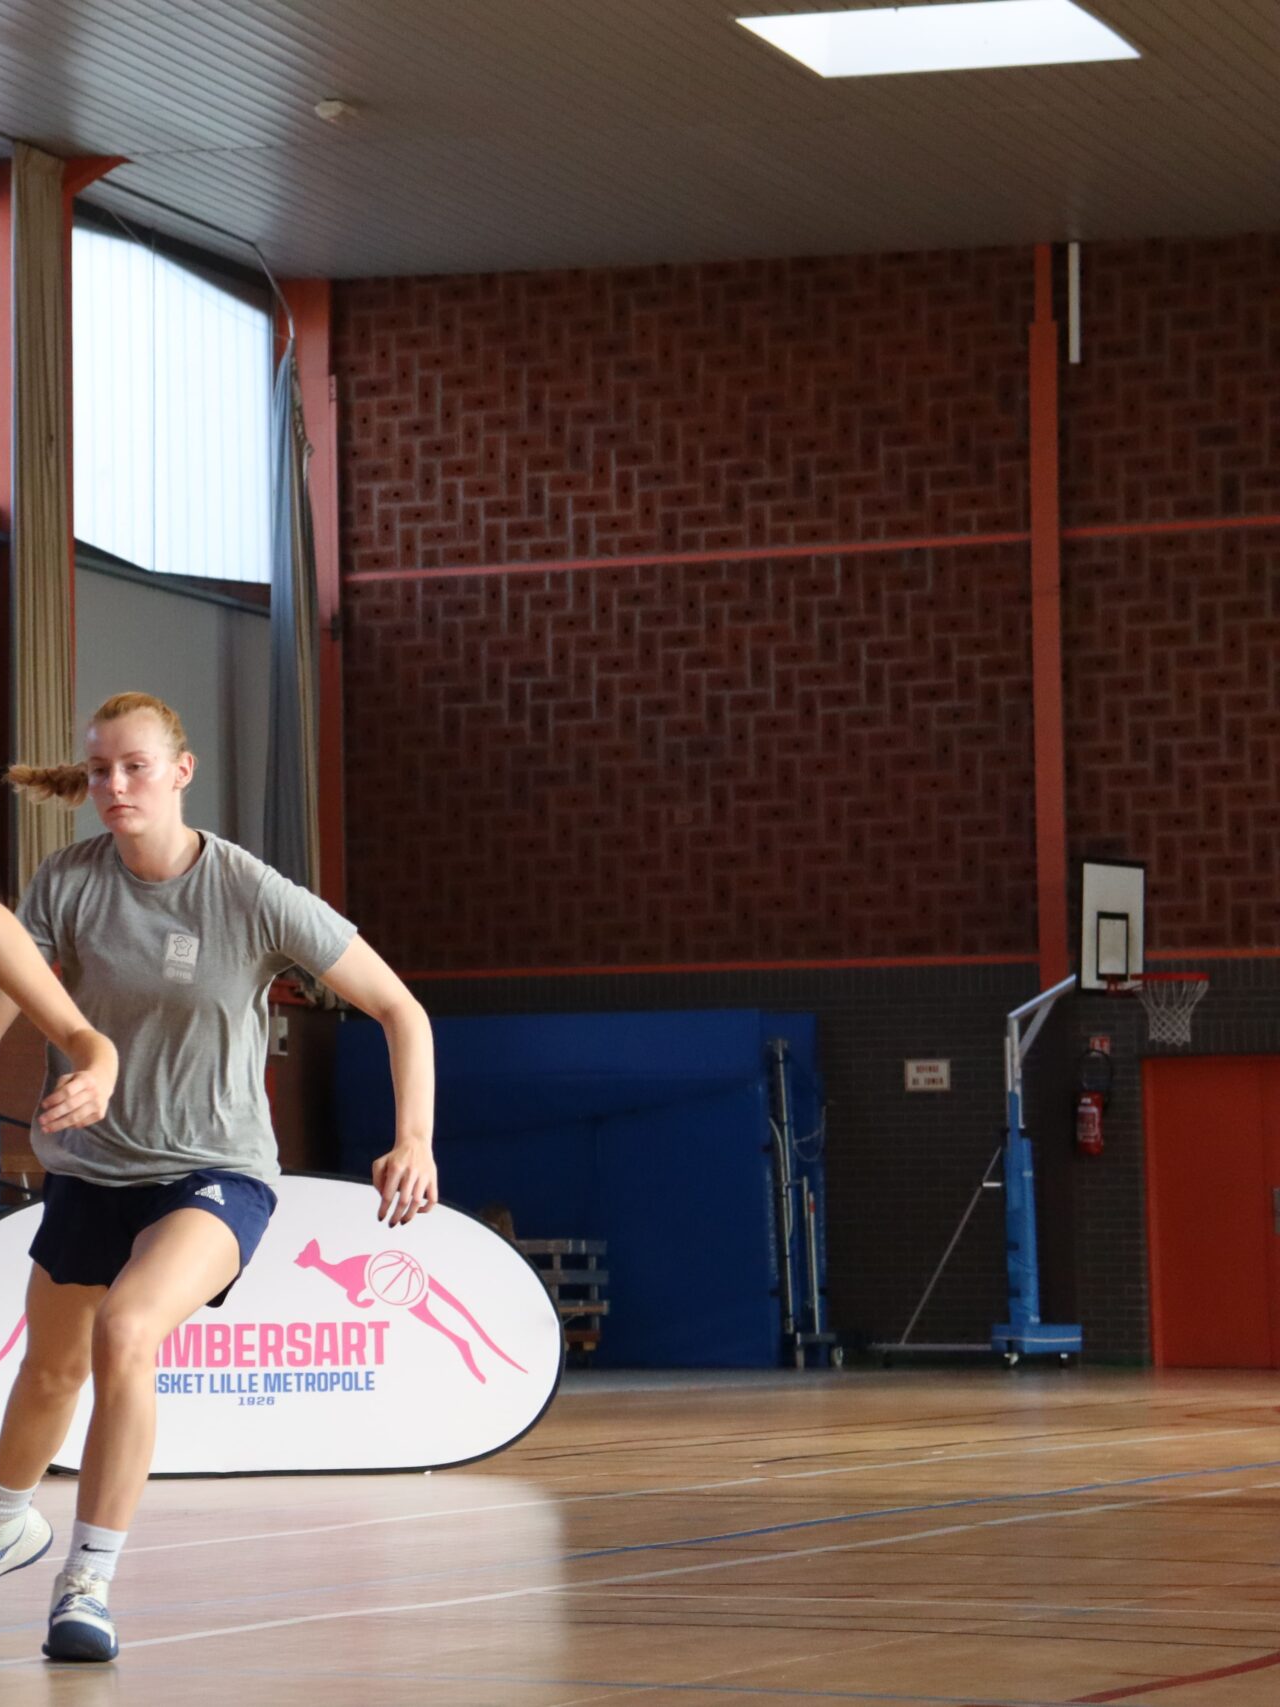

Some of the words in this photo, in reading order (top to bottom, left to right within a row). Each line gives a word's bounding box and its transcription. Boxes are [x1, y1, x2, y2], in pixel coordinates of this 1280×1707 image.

[155, 1321, 390, 1368] MBERSART
[155, 1373, 204, 1394] SKET
[210, 1372, 258, 1394] LILLE
[263, 1371, 375, 1393] METROPOLE
[237, 1396, 276, 1406] 1926
